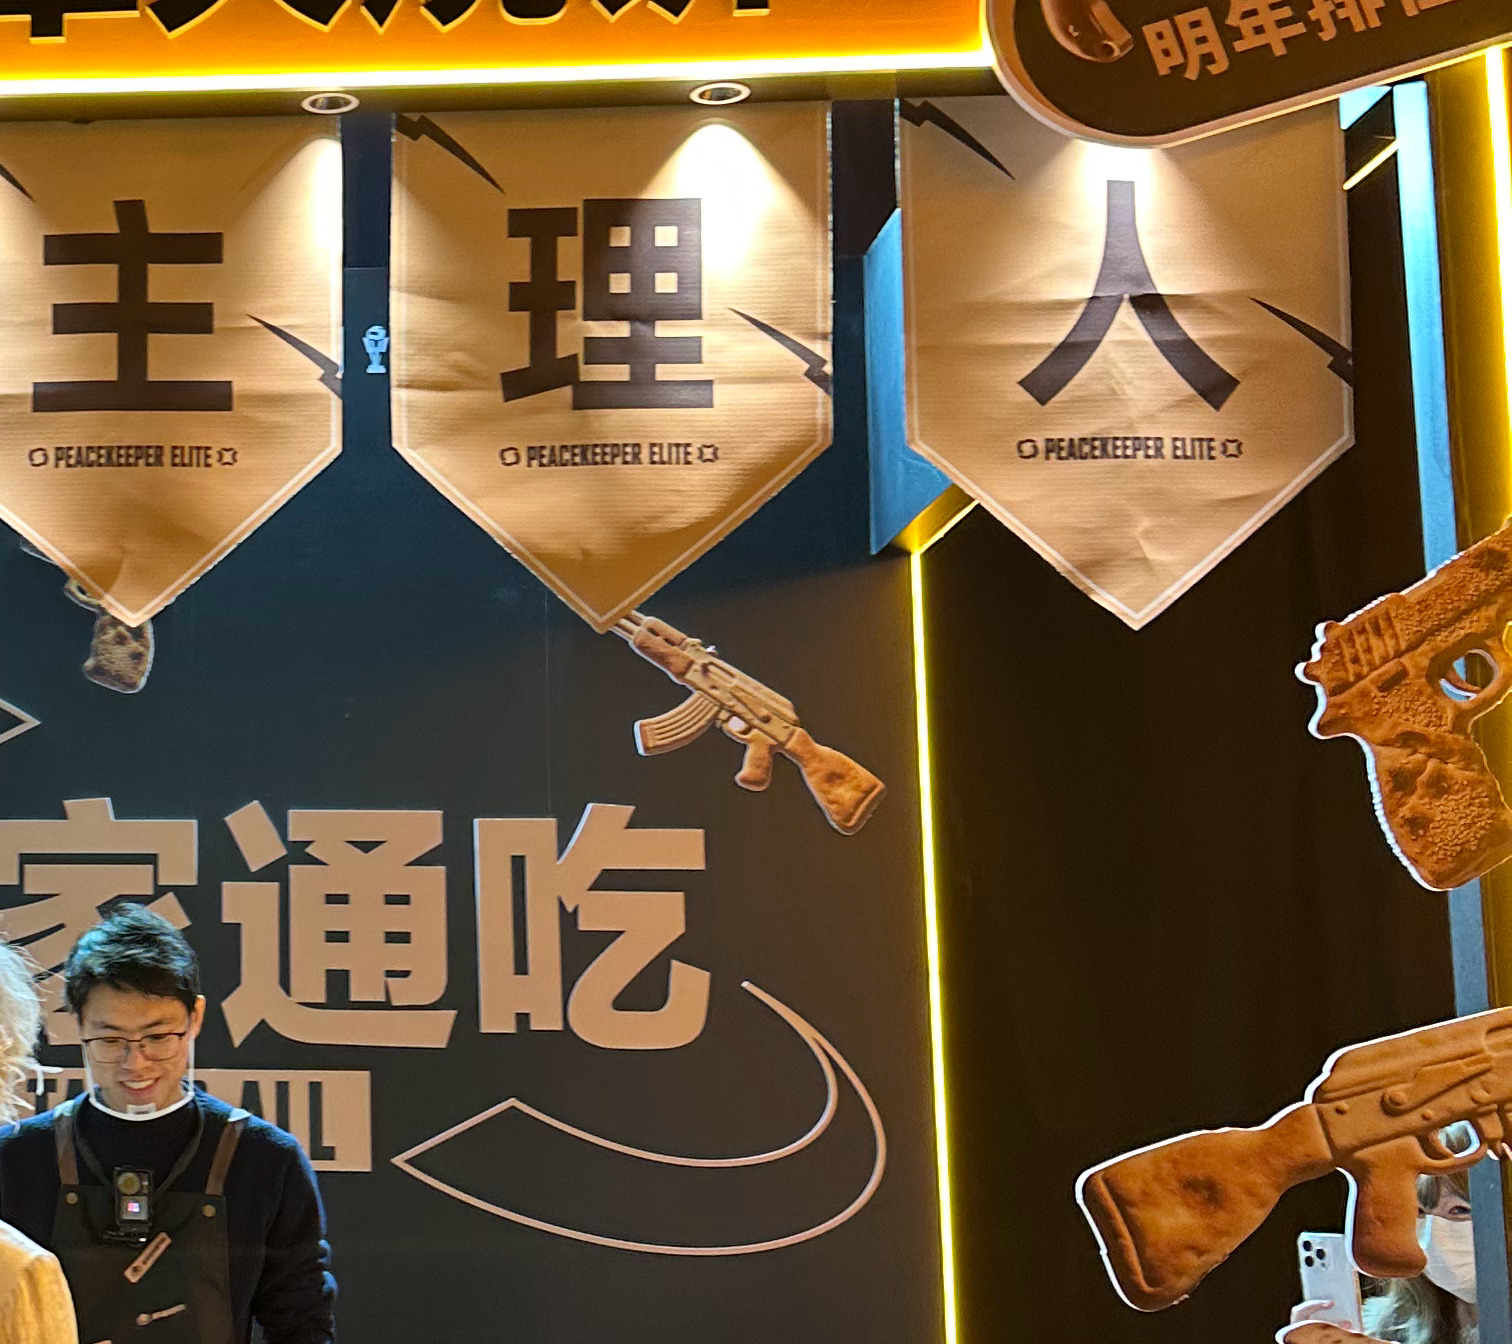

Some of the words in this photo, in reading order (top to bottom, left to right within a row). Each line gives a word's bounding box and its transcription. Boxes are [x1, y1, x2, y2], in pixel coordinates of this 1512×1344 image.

[31, 199, 234, 414] 主
[500, 197, 715, 410] 理
[1016, 179, 1241, 412] 人
[54, 445, 165, 468] PEACEKEEPER
[170, 445, 213, 467] ELITE
[526, 442, 643, 468] PEACEKEEPER
[648, 442, 693, 466] ELITE
[1044, 436, 1165, 461] PEACEKEEPER
[1171, 436, 1217, 460] ELITE
